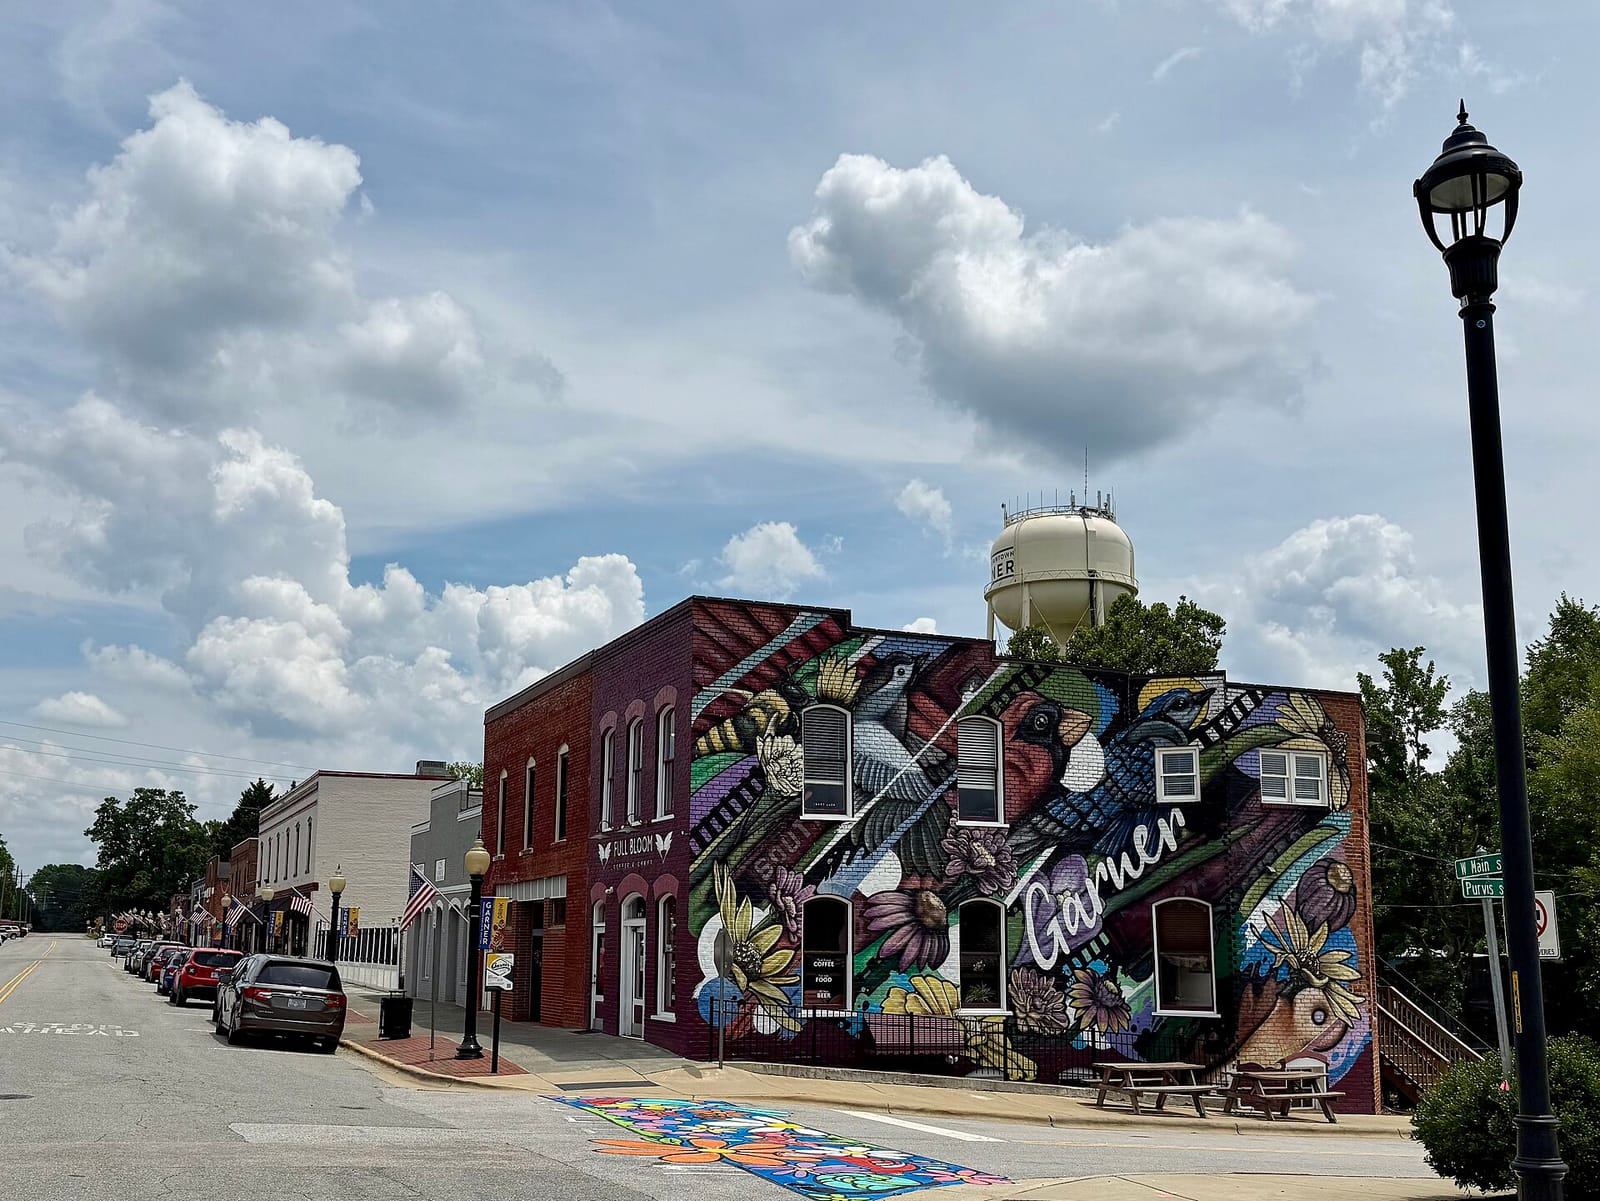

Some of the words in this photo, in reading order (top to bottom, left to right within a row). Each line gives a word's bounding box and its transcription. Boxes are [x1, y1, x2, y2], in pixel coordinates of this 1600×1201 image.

[613, 839, 628, 857] FULL
[629, 834, 653, 855] BLOOM
[754, 819, 812, 881] SOUT
[1460, 861, 1467, 875] W
[1470, 859, 1490, 873] Main
[1496, 859, 1502, 871] S
[1025, 808, 1186, 970] Garner
[1465, 881, 1494, 896] Purvis
[1498, 885, 1504, 896] S
[482, 901, 492, 945] GARNER
